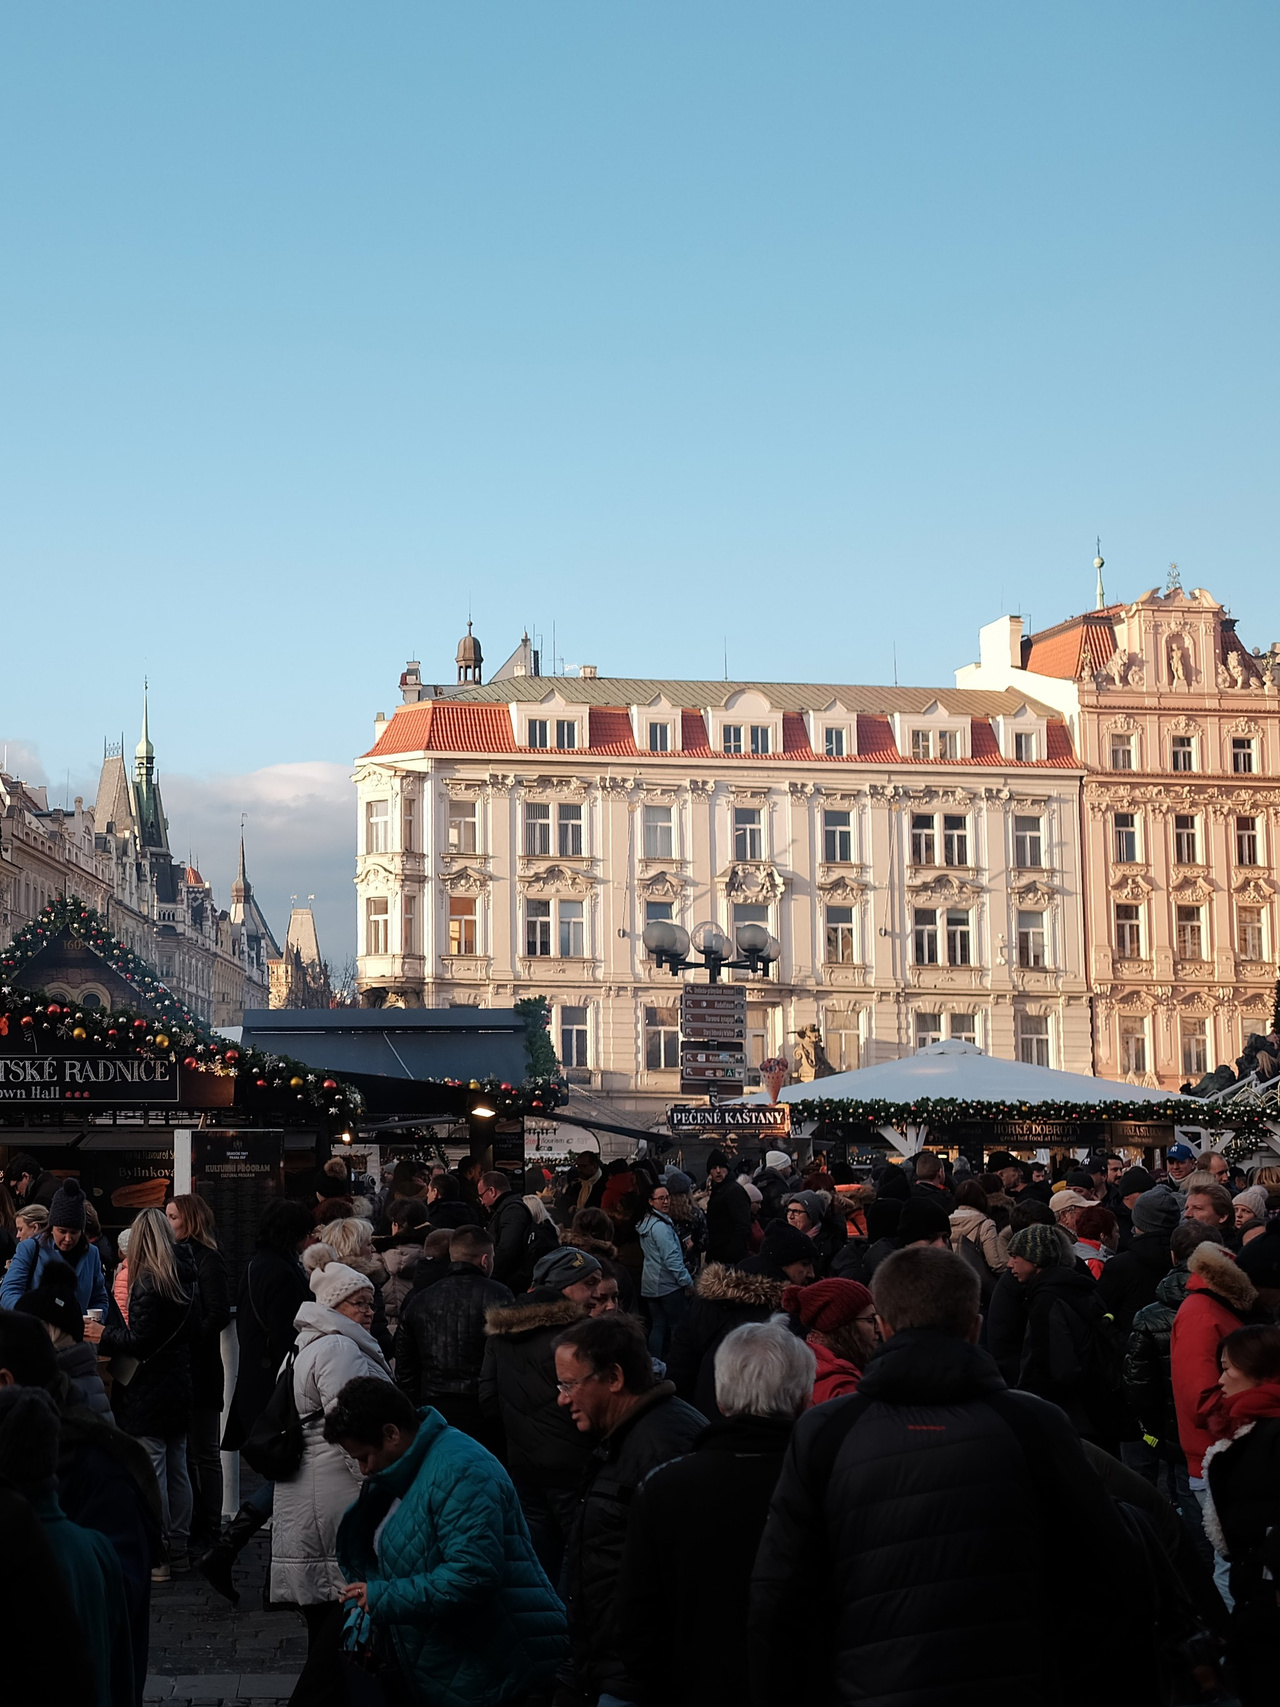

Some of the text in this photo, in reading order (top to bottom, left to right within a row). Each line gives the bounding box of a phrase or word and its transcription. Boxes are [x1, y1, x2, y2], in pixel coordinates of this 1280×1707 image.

[64, 1059, 170, 1084] RADNICE
[31, 1085, 60, 1099] Hall
[673, 1108, 784, 1124] PEČENÉ KAŠTANY
[237, 1163, 270, 1172] PROGRAM
